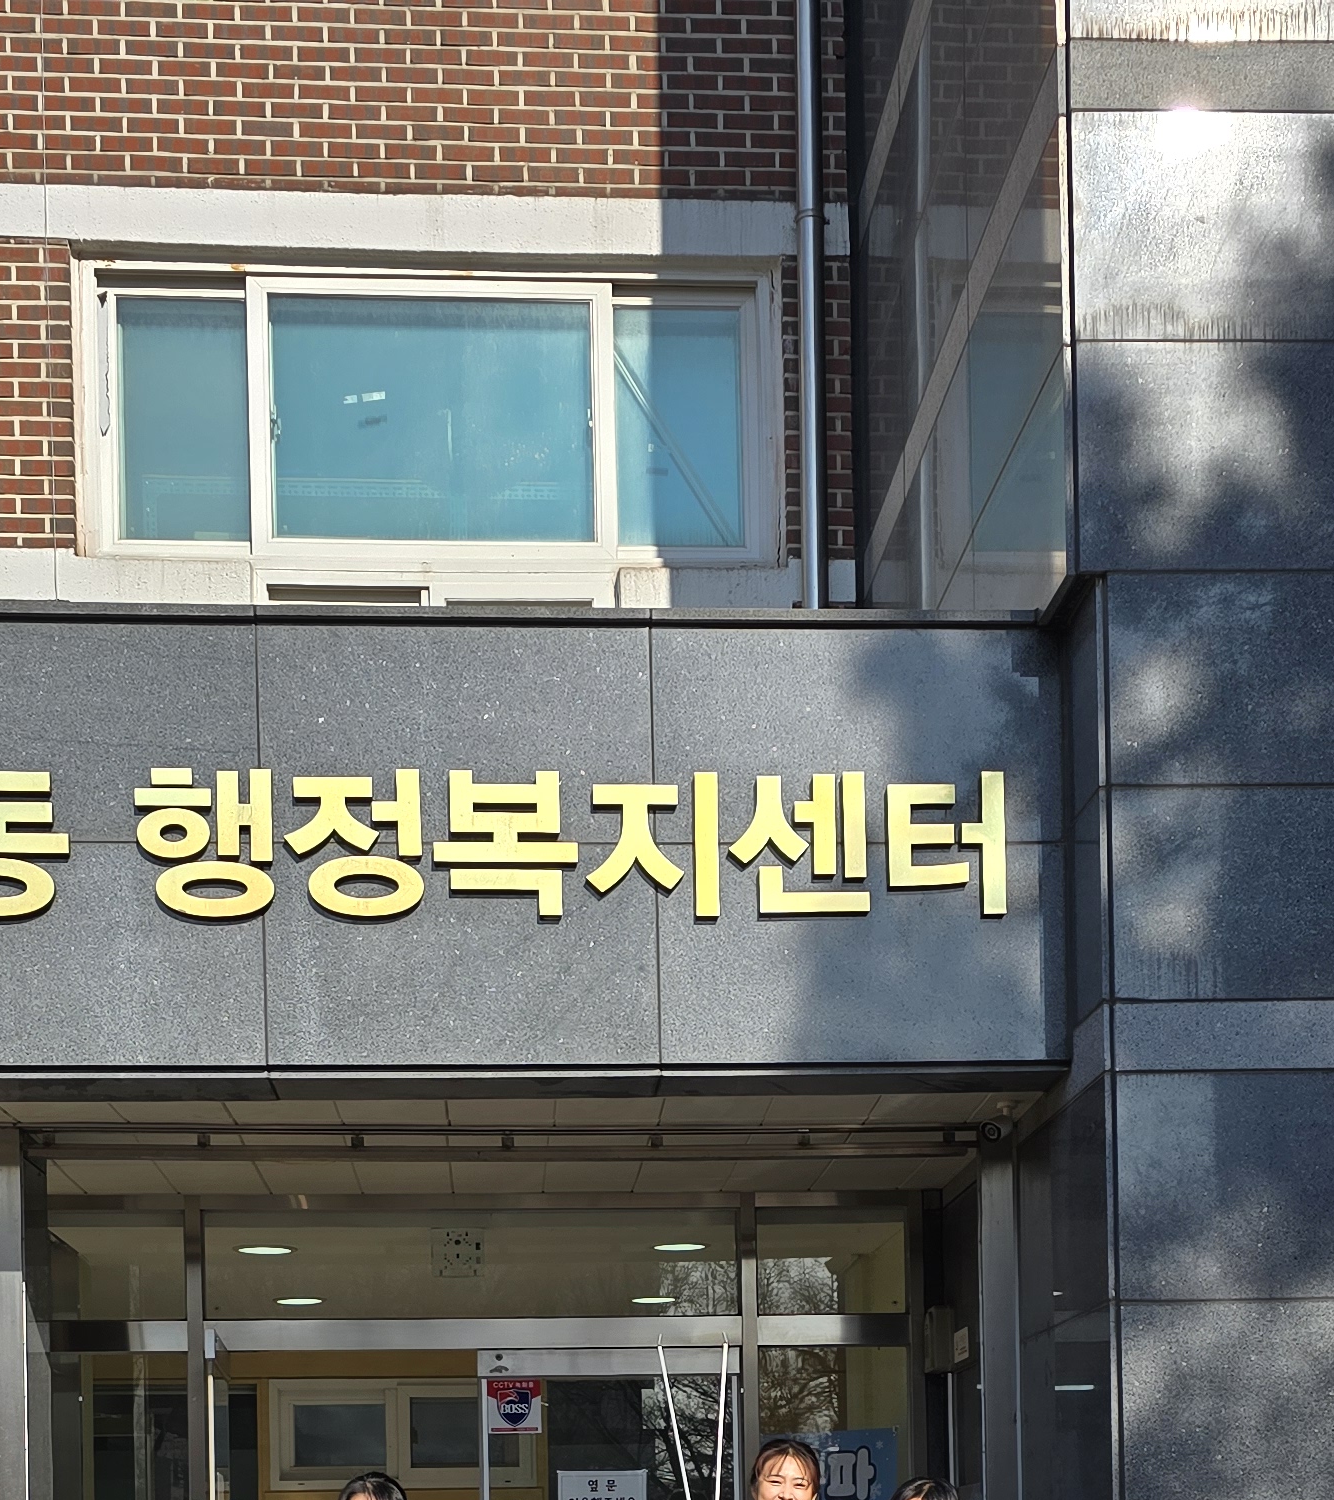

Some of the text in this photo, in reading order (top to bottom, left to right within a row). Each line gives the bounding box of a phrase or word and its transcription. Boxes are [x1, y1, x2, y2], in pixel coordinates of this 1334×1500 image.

[133, 767, 1008, 920] 행정복지센터
[492, 1381, 514, 1389] CCTV
[500, 1403, 529, 1414] BOSS
[605, 1479, 618, 1492] 문
